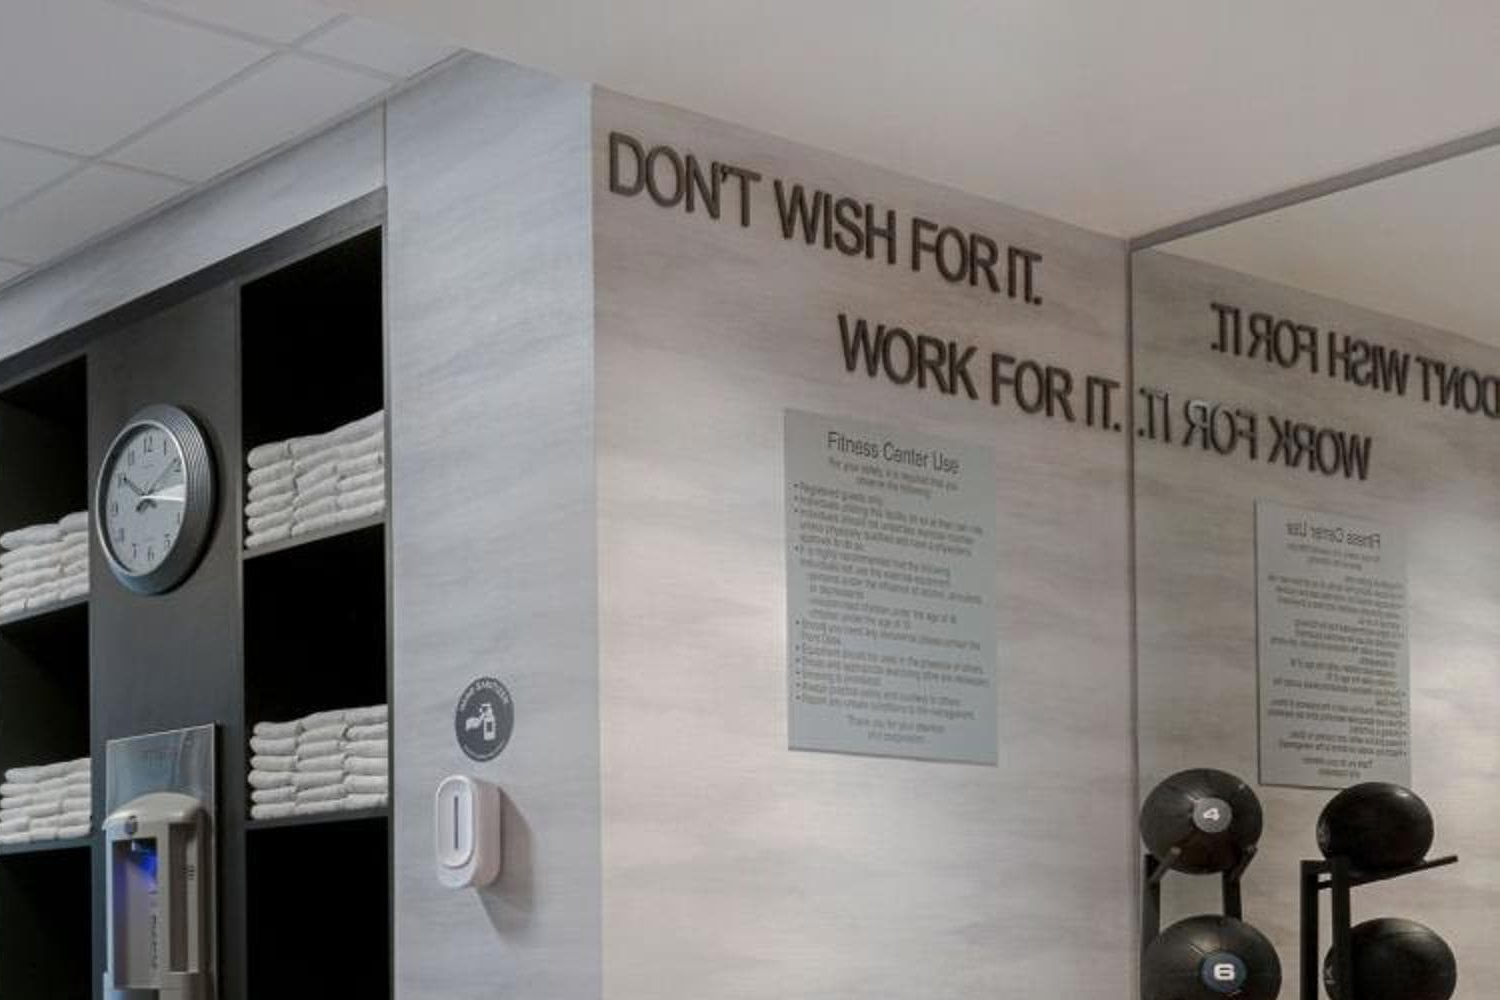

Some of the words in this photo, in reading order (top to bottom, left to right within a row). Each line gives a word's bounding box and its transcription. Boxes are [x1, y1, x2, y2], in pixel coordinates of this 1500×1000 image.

[608, 131, 762, 228] DON'T
[773, 178, 897, 265] WISH
[910, 216, 1000, 294] FOR
[1006, 246, 1044, 305] IT.
[837, 314, 979, 401] WORK
[990, 351, 1076, 422] FOR
[1085, 375, 1122, 432] IT.
[827, 431, 880, 459] Fitness
[932, 452, 961, 475] Use
[1203, 807, 1220, 822] 4
[1213, 962, 1236, 981] 6
